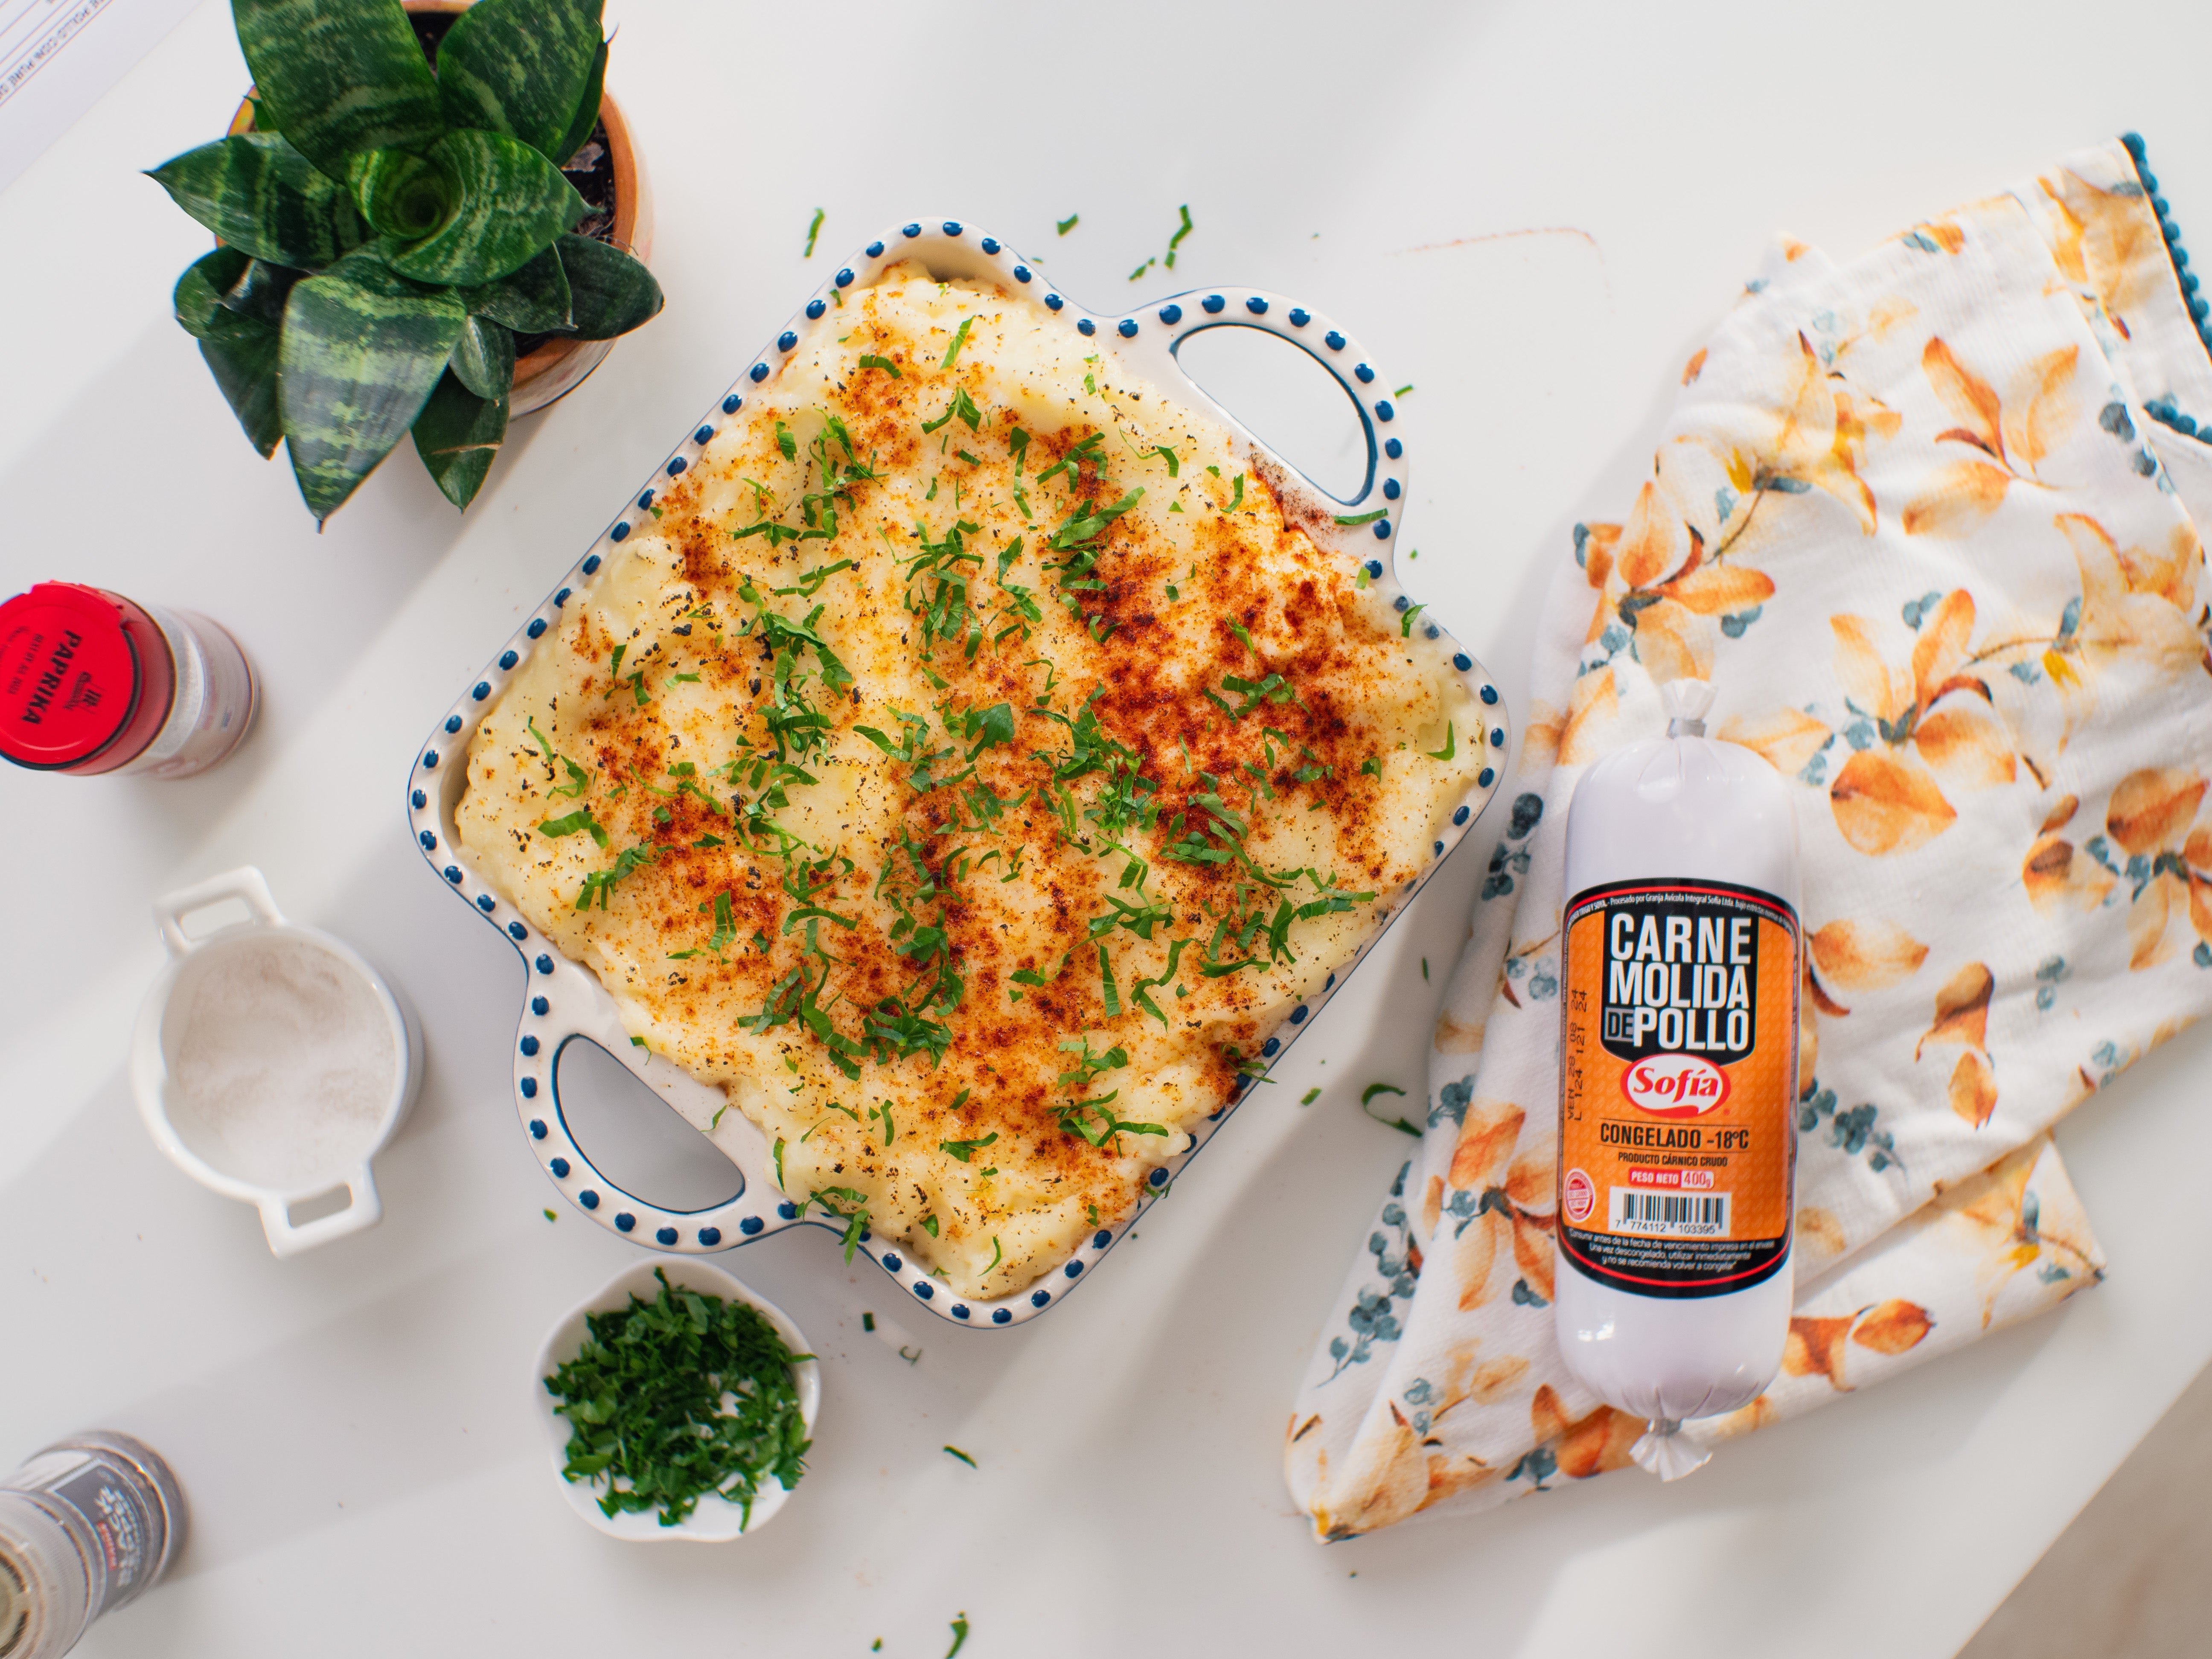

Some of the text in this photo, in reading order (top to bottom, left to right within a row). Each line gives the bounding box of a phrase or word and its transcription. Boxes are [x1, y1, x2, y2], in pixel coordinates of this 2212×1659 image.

[21, 629, 82, 724] PAPRIKA
[1636, 895, 1645, 905] por
[1645, 893, 1663, 904] Granja
[1610, 913, 1752, 964] CARNE
[1609, 960, 1749, 1009] MOLIDA
[1571, 988, 1578, 1011] 24
[1578, 990, 1587, 1013] 24
[1607, 1007, 1749, 1051] DE POLLO
[1575, 1068, 1583, 1097] 124
[1633, 1066, 1718, 1103] Sofía
[1574, 1112, 1582, 1121] L
[1601, 1123, 1701, 1149] CONGELADO
[1618, 1152, 1728, 1167] PRODUCTO CÁRNICO CRUDO
[1630, 1171, 1711, 1188] PESO NETO 400g
[1615, 1219, 1621, 1228] 7
[1631, 1221, 1666, 1233] 774112
[1589, 1242, 1602, 1252] Una
[1602, 1246, 1615, 1255] vez
[1668, 1250, 1694, 1260] utilizar
[1593, 1233, 1612, 1245] antes
[1612, 1235, 1621, 1246] de
[1622, 1237, 1629, 1247] la
[1630, 1238, 1651, 1249] fecha
[1652, 1240, 1663, 1249] de
[1664, 1241, 1710, 1252] vencimiento
[1601, 1255, 1607, 1265] y
[1607, 1256, 1617, 1265] no
[1617, 1257, 1627, 1266] se
[1627, 1257, 1672, 1270] recomienda
